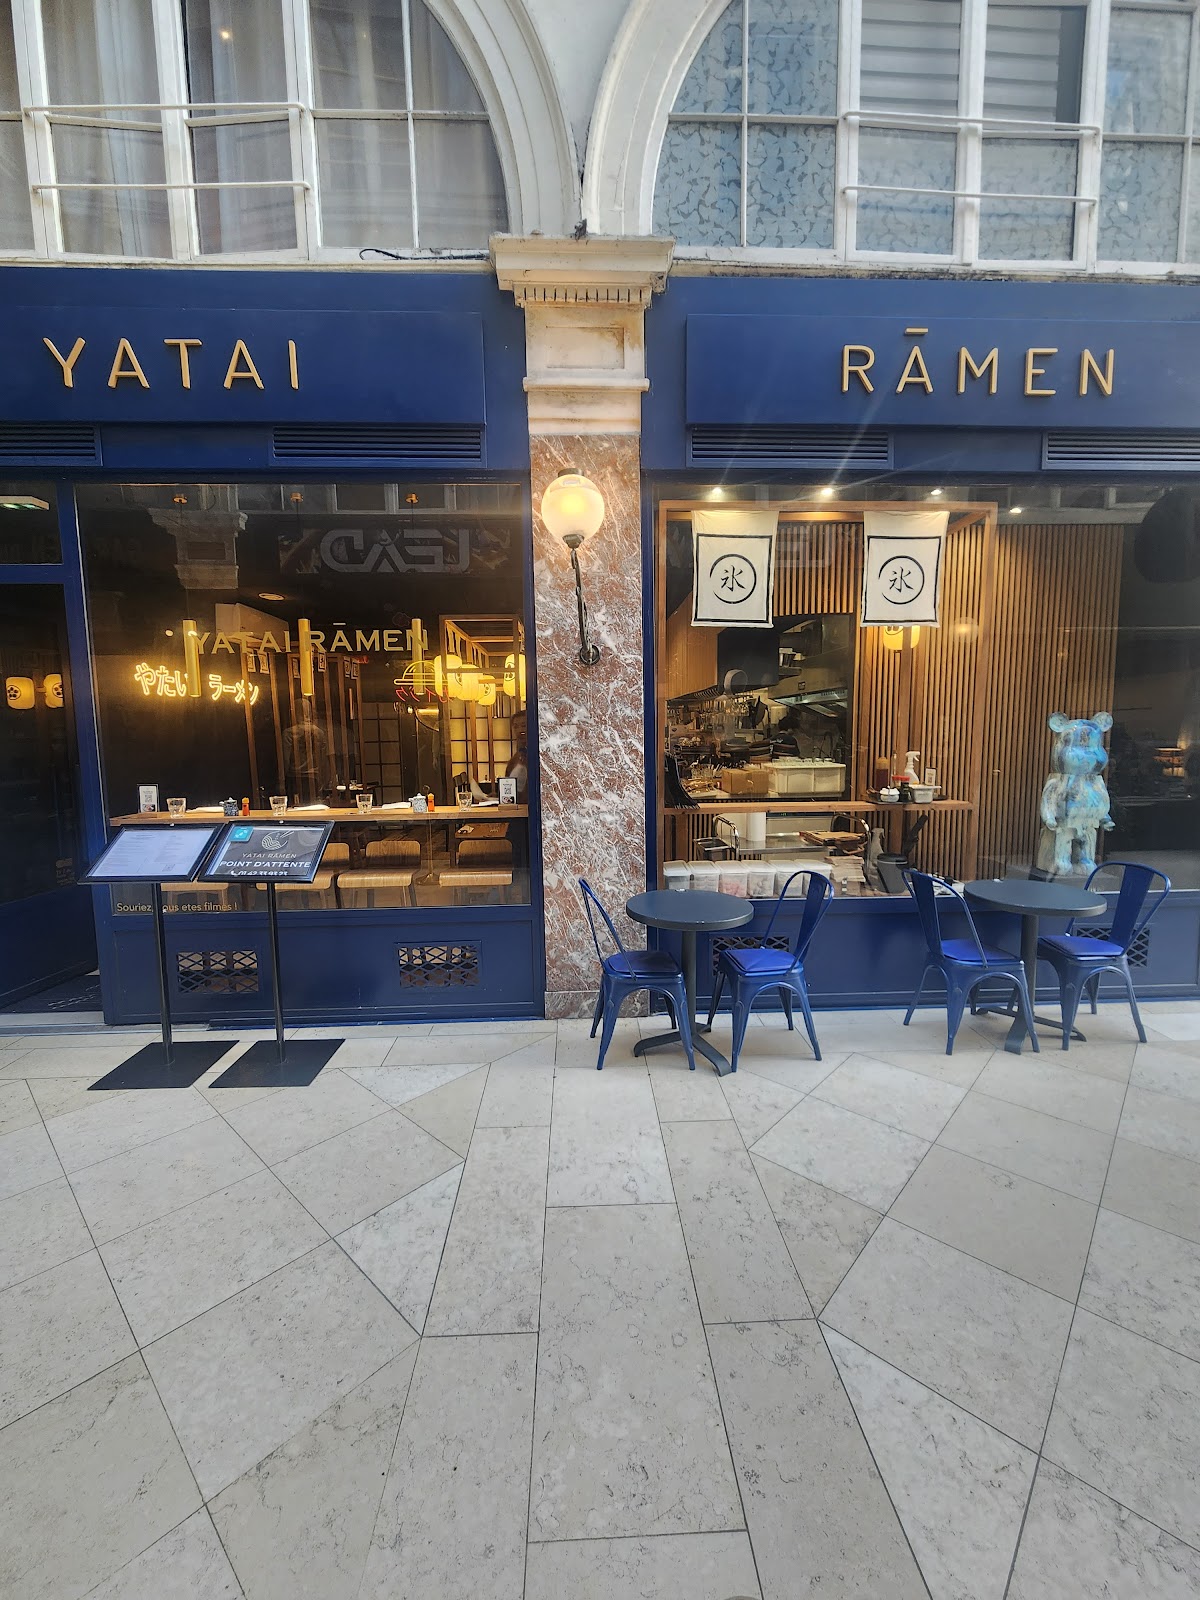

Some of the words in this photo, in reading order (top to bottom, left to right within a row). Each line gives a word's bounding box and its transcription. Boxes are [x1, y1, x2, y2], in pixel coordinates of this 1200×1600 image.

[43, 337, 299, 391] YATAI
[840, 327, 1116, 397] RĀMEN
[720, 564, 747, 593] 氷
[888, 566, 915, 594] 氷
[187, 630, 292, 654] YATAI
[219, 860, 253, 868] POINT
[253, 860, 312, 868] D'ATTENTE
